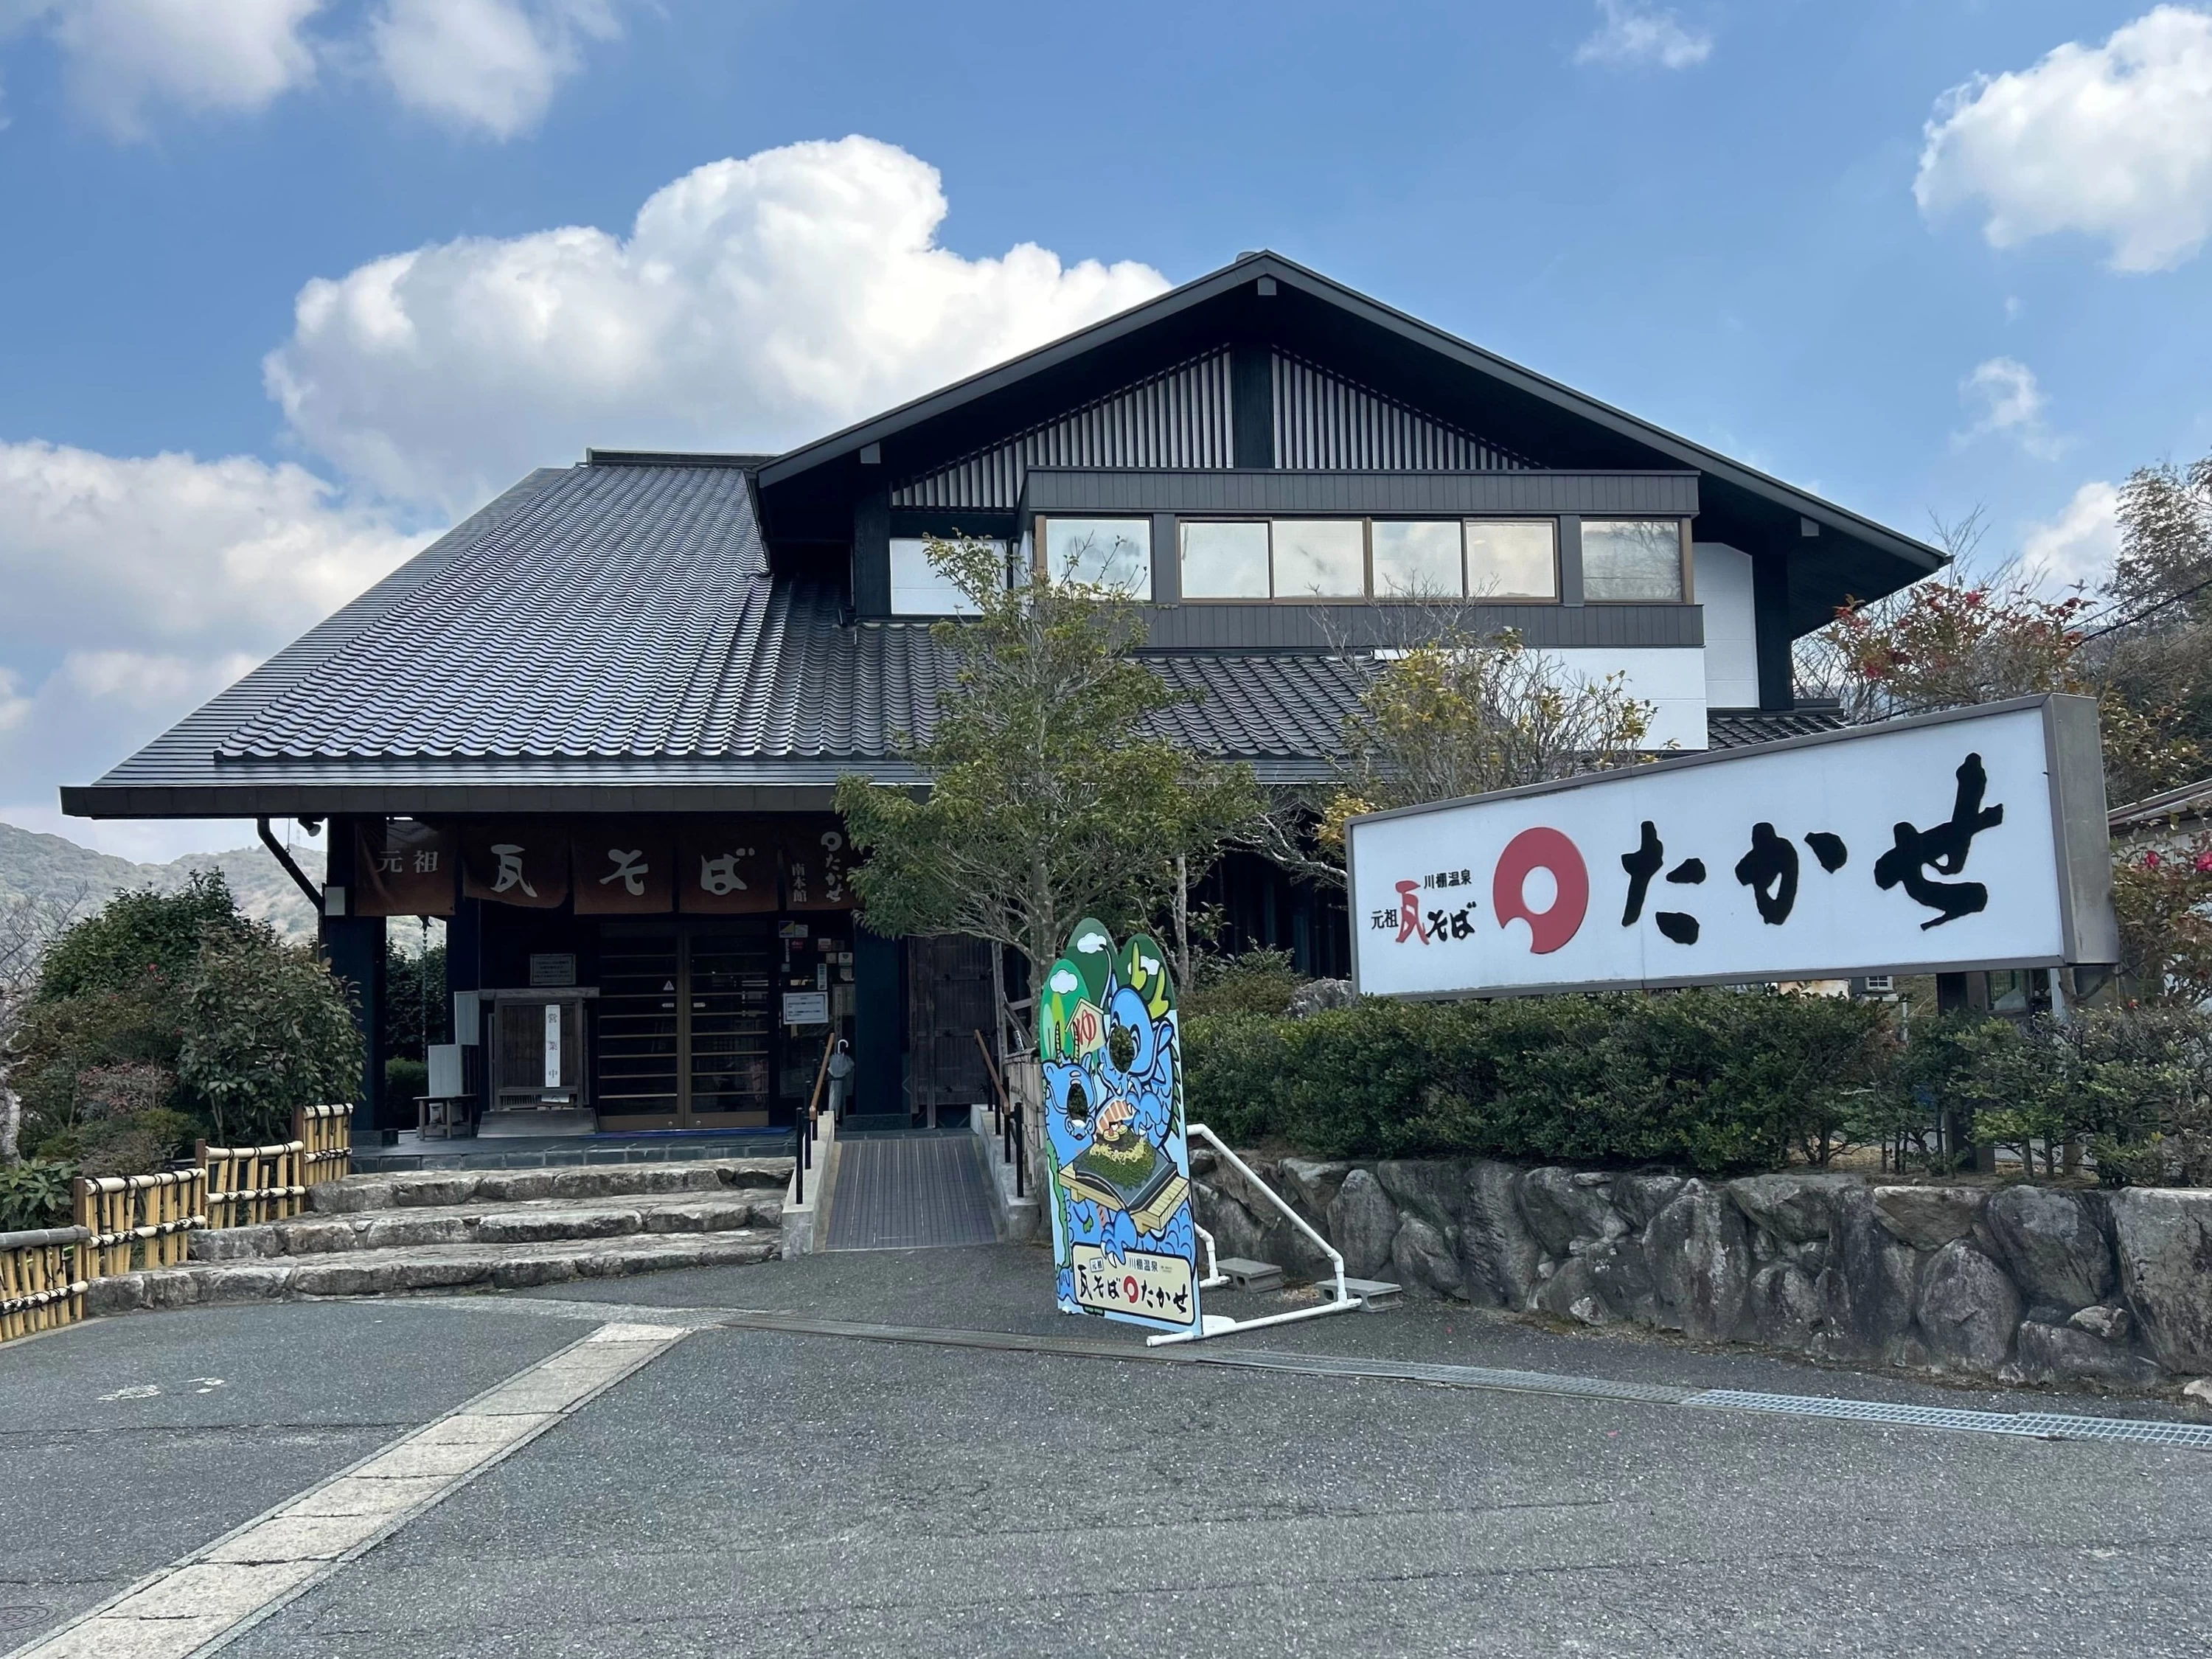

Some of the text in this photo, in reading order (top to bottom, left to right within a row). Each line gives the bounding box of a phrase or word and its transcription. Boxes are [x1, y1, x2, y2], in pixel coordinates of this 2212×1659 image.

[378, 850, 438, 873] 元祖
[1621, 752, 2003, 945] たかせ
[825, 853, 843, 902] たかせ
[1424, 869, 1472, 889] 川棚温泉
[548, 1013, 557, 1079] 営業中
[1076, 1009, 1097, 1048] ゆ
[1129, 1257, 1158, 1272] 川棚温泉
[1077, 1265, 1188, 1314] 瓦そば たかせ
